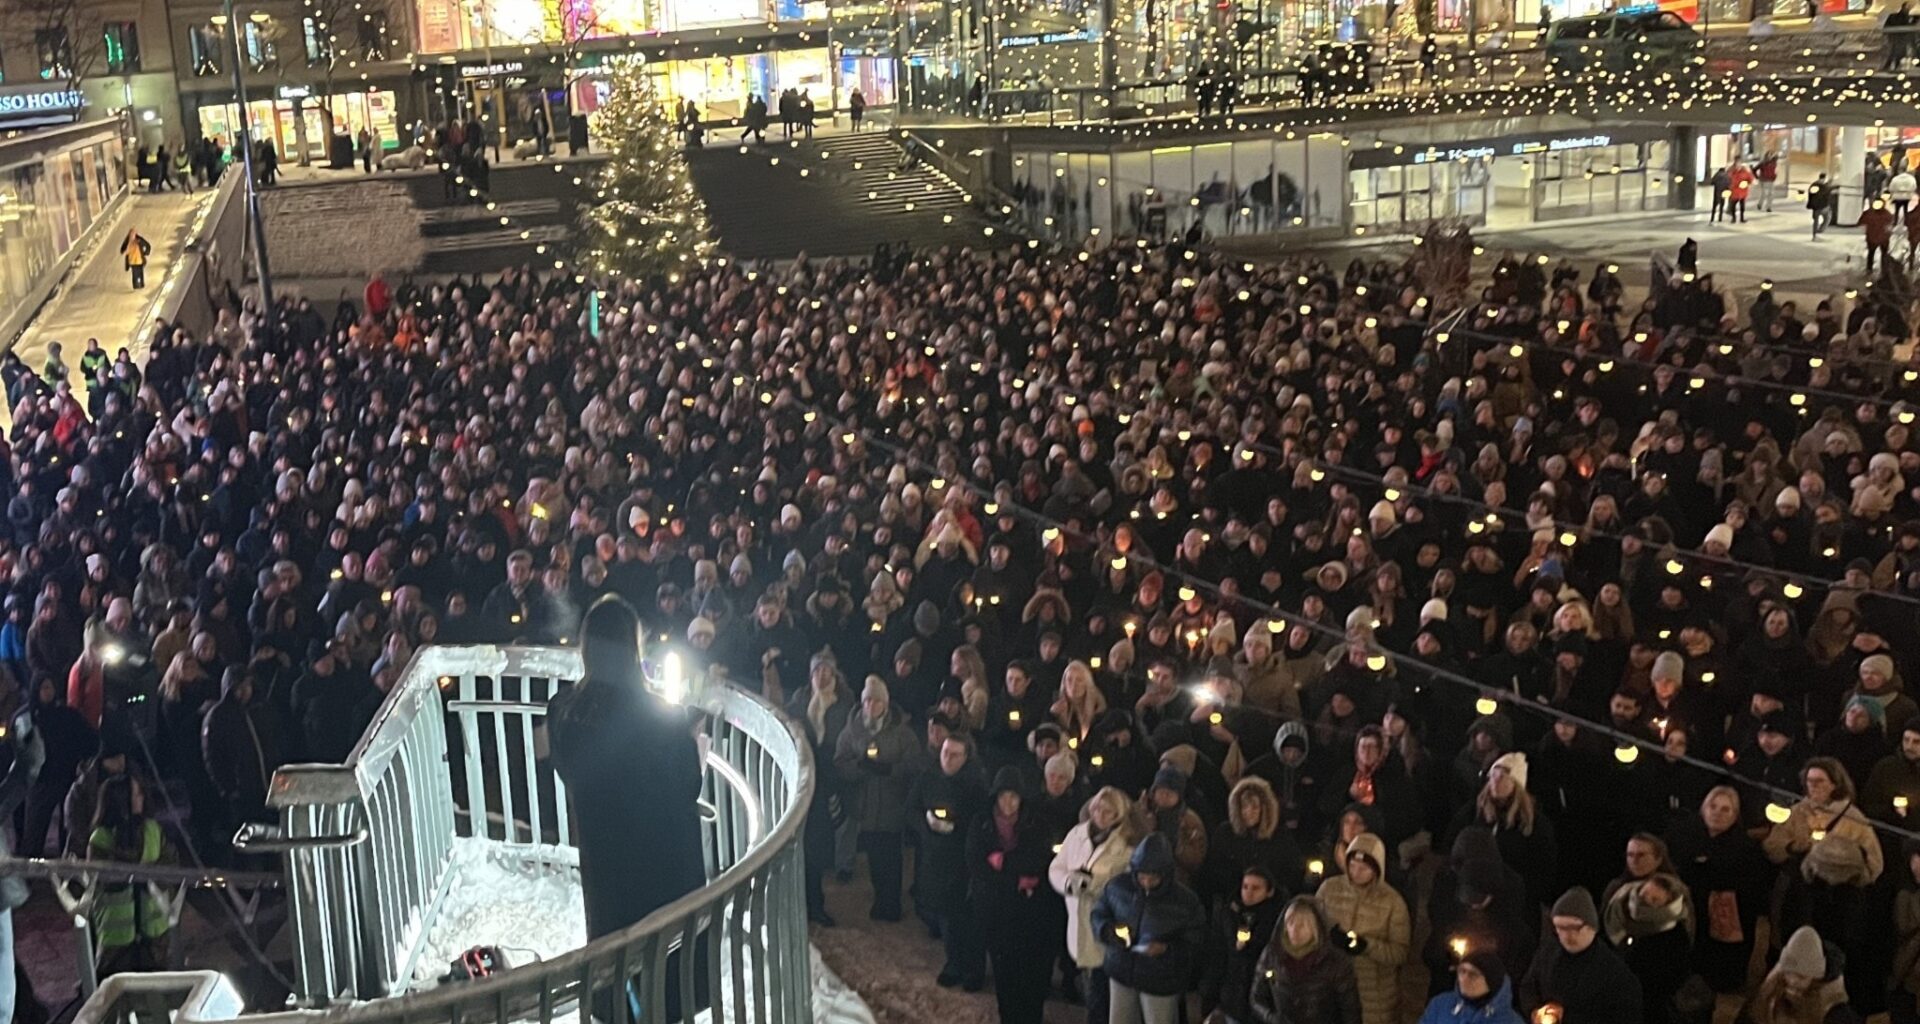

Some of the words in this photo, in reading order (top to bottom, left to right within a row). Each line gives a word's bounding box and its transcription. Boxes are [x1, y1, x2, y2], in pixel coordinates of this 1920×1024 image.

[0, 95, 24, 110] SO
[1549, 138, 1593, 151] Stockholm
[1593, 135, 1610, 147] City
